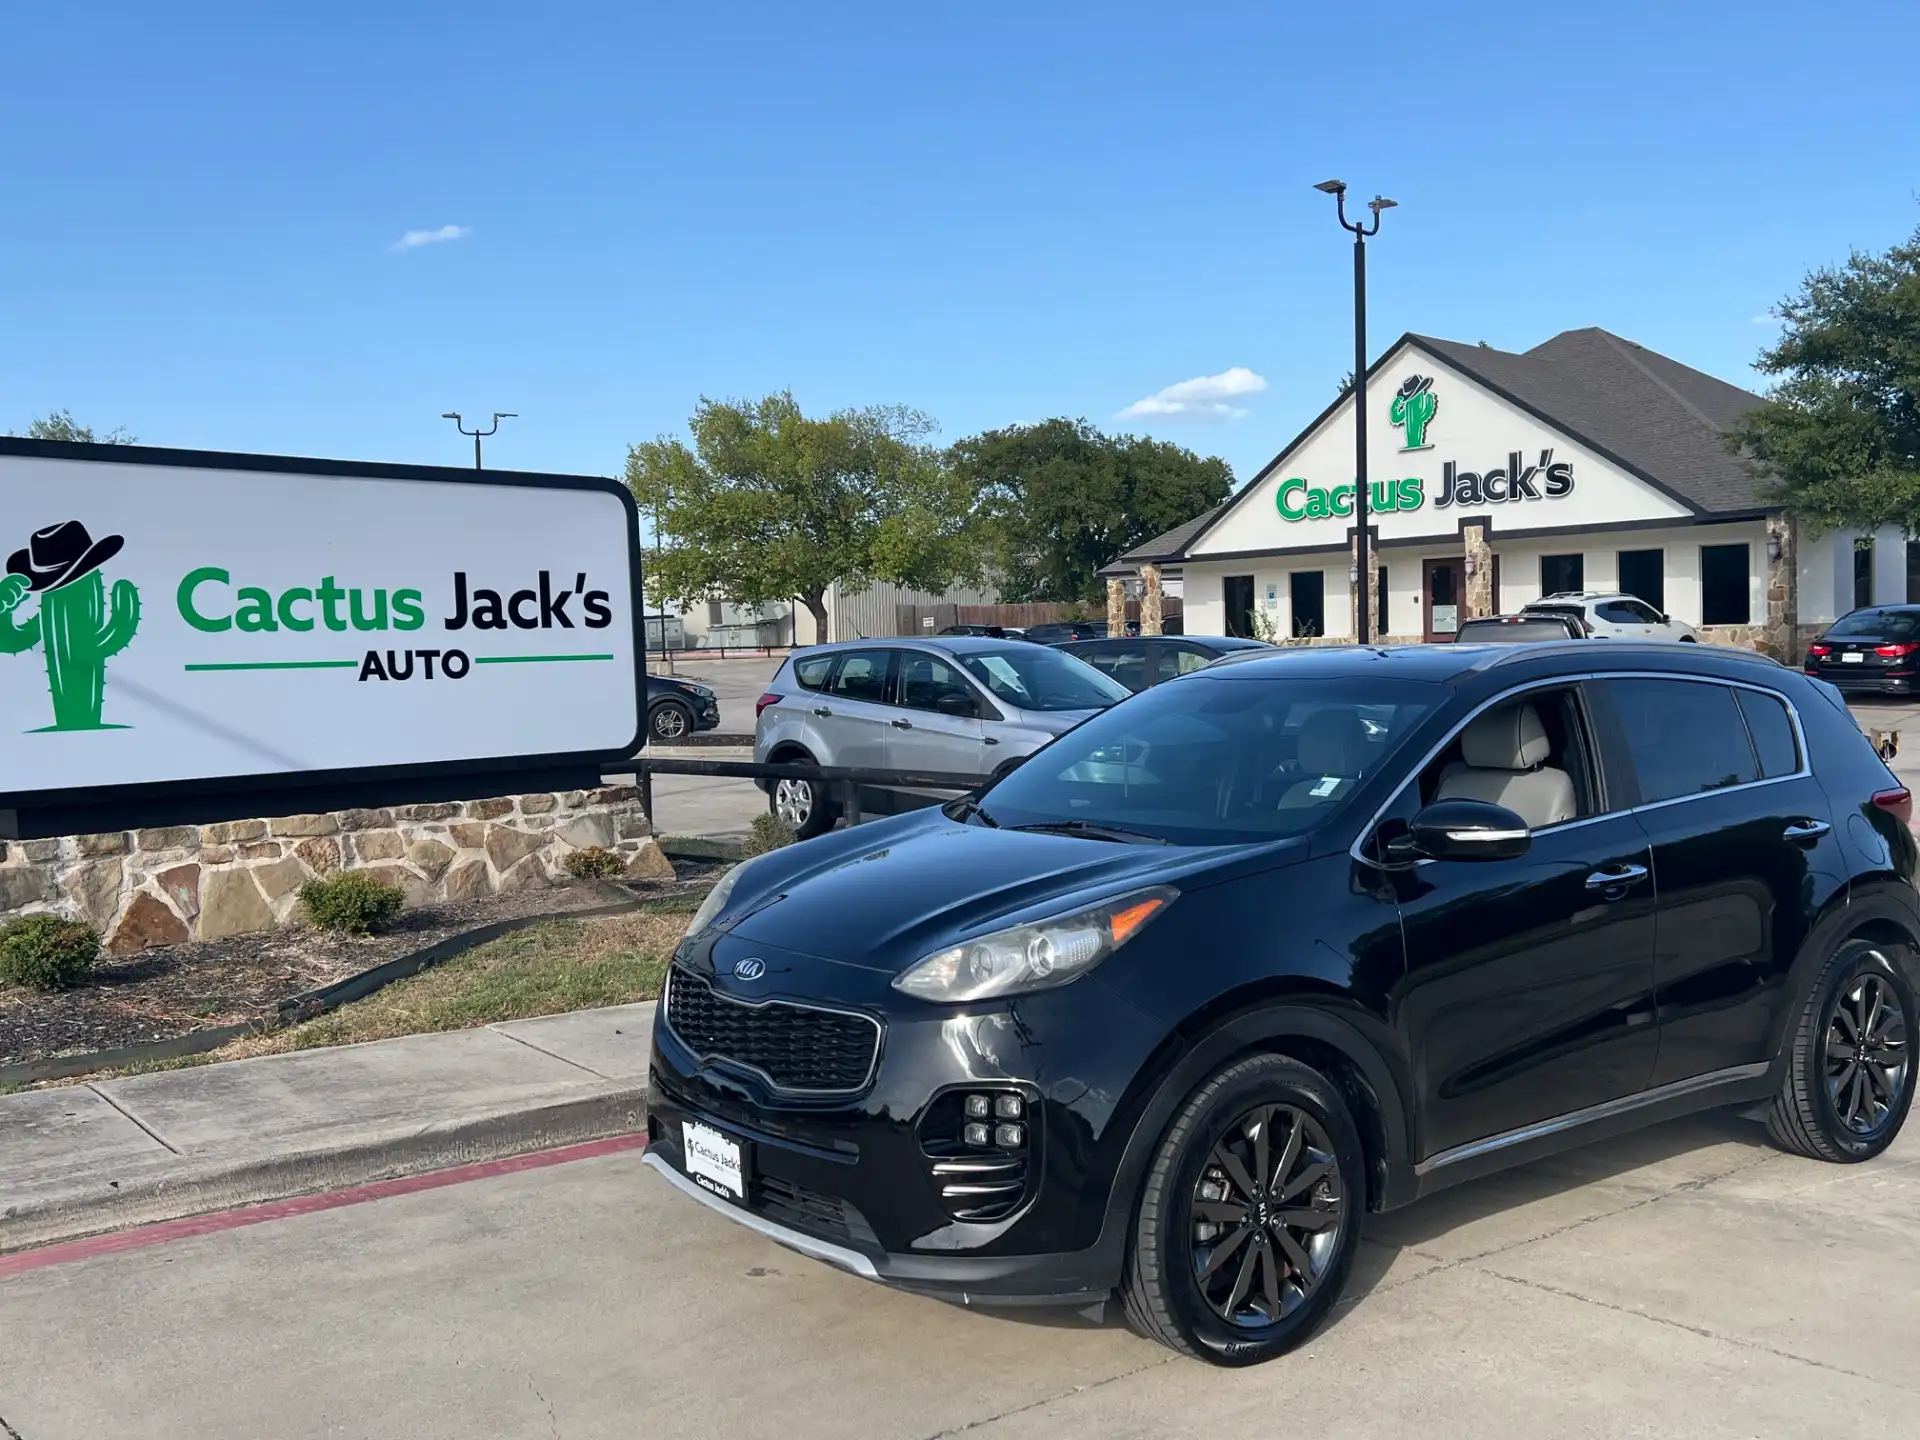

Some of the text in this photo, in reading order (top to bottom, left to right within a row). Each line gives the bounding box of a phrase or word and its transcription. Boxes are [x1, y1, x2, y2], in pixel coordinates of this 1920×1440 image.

[1433, 448, 1575, 509] Jack's
[176, 566, 612, 633] Cactus Jack's
[358, 649, 470, 682] AUTO
[736, 959, 759, 977] KIA
[695, 1141, 741, 1172] Cactus Jack's
[1259, 1202, 1267, 1225] KIA
